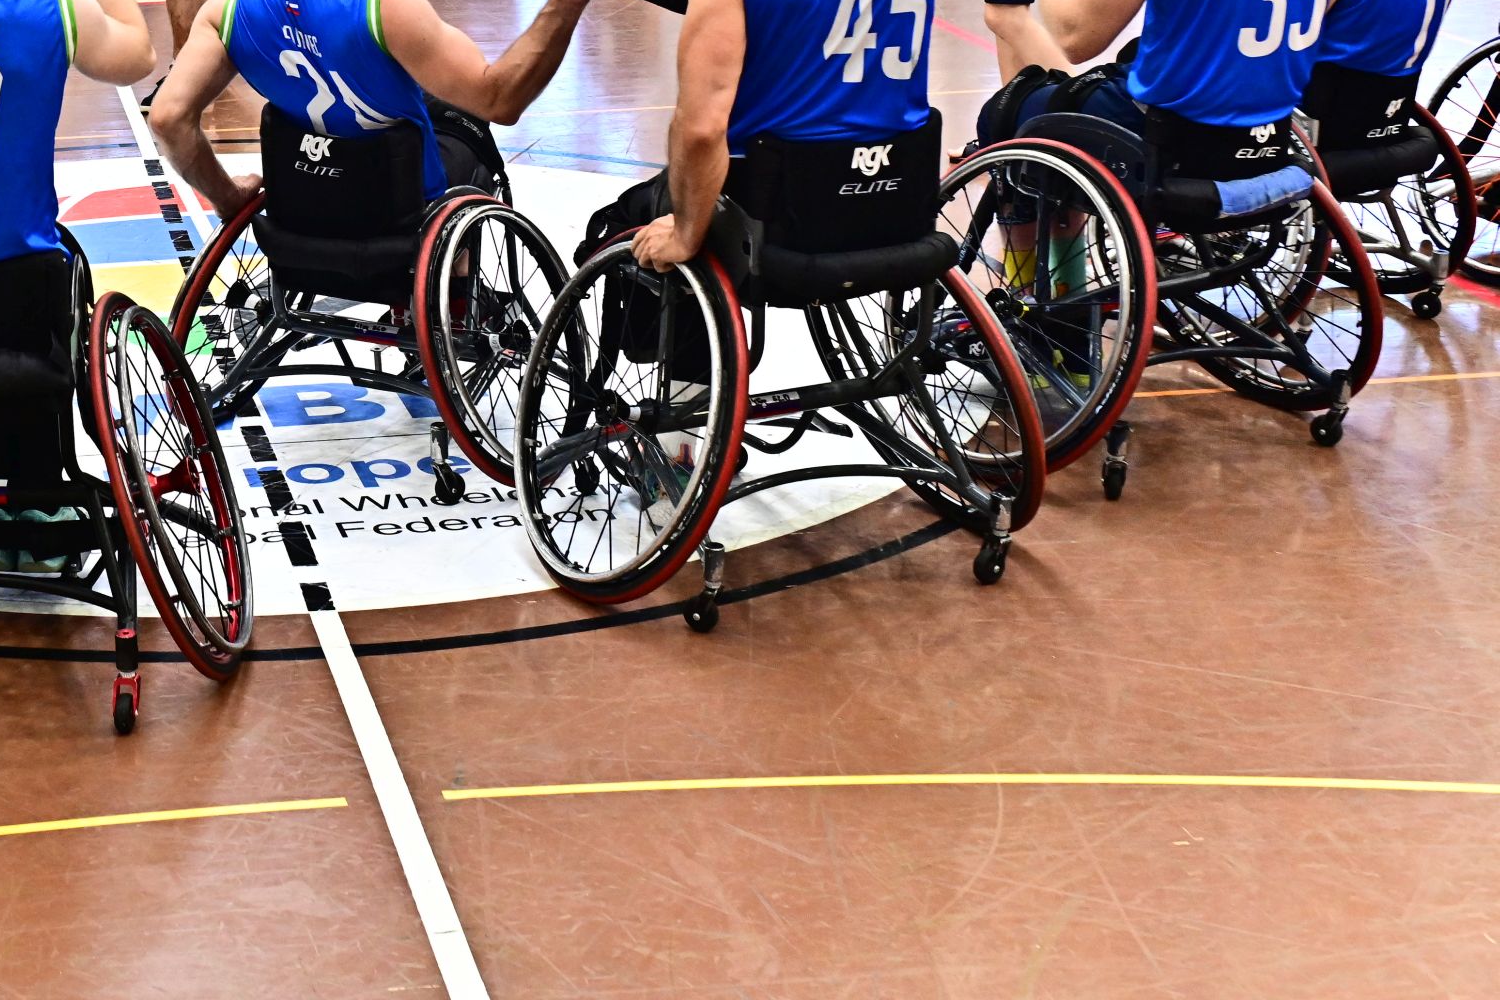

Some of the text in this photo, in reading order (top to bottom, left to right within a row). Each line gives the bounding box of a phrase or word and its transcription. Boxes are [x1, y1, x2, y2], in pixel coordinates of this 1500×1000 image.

[1366, 123, 1402, 138] ELITE
[1235, 146, 1280, 159] ELITE
[294, 161, 343, 178] ELITE
[839, 178, 902, 195] ELITE
[243, 454, 472, 488] rope
